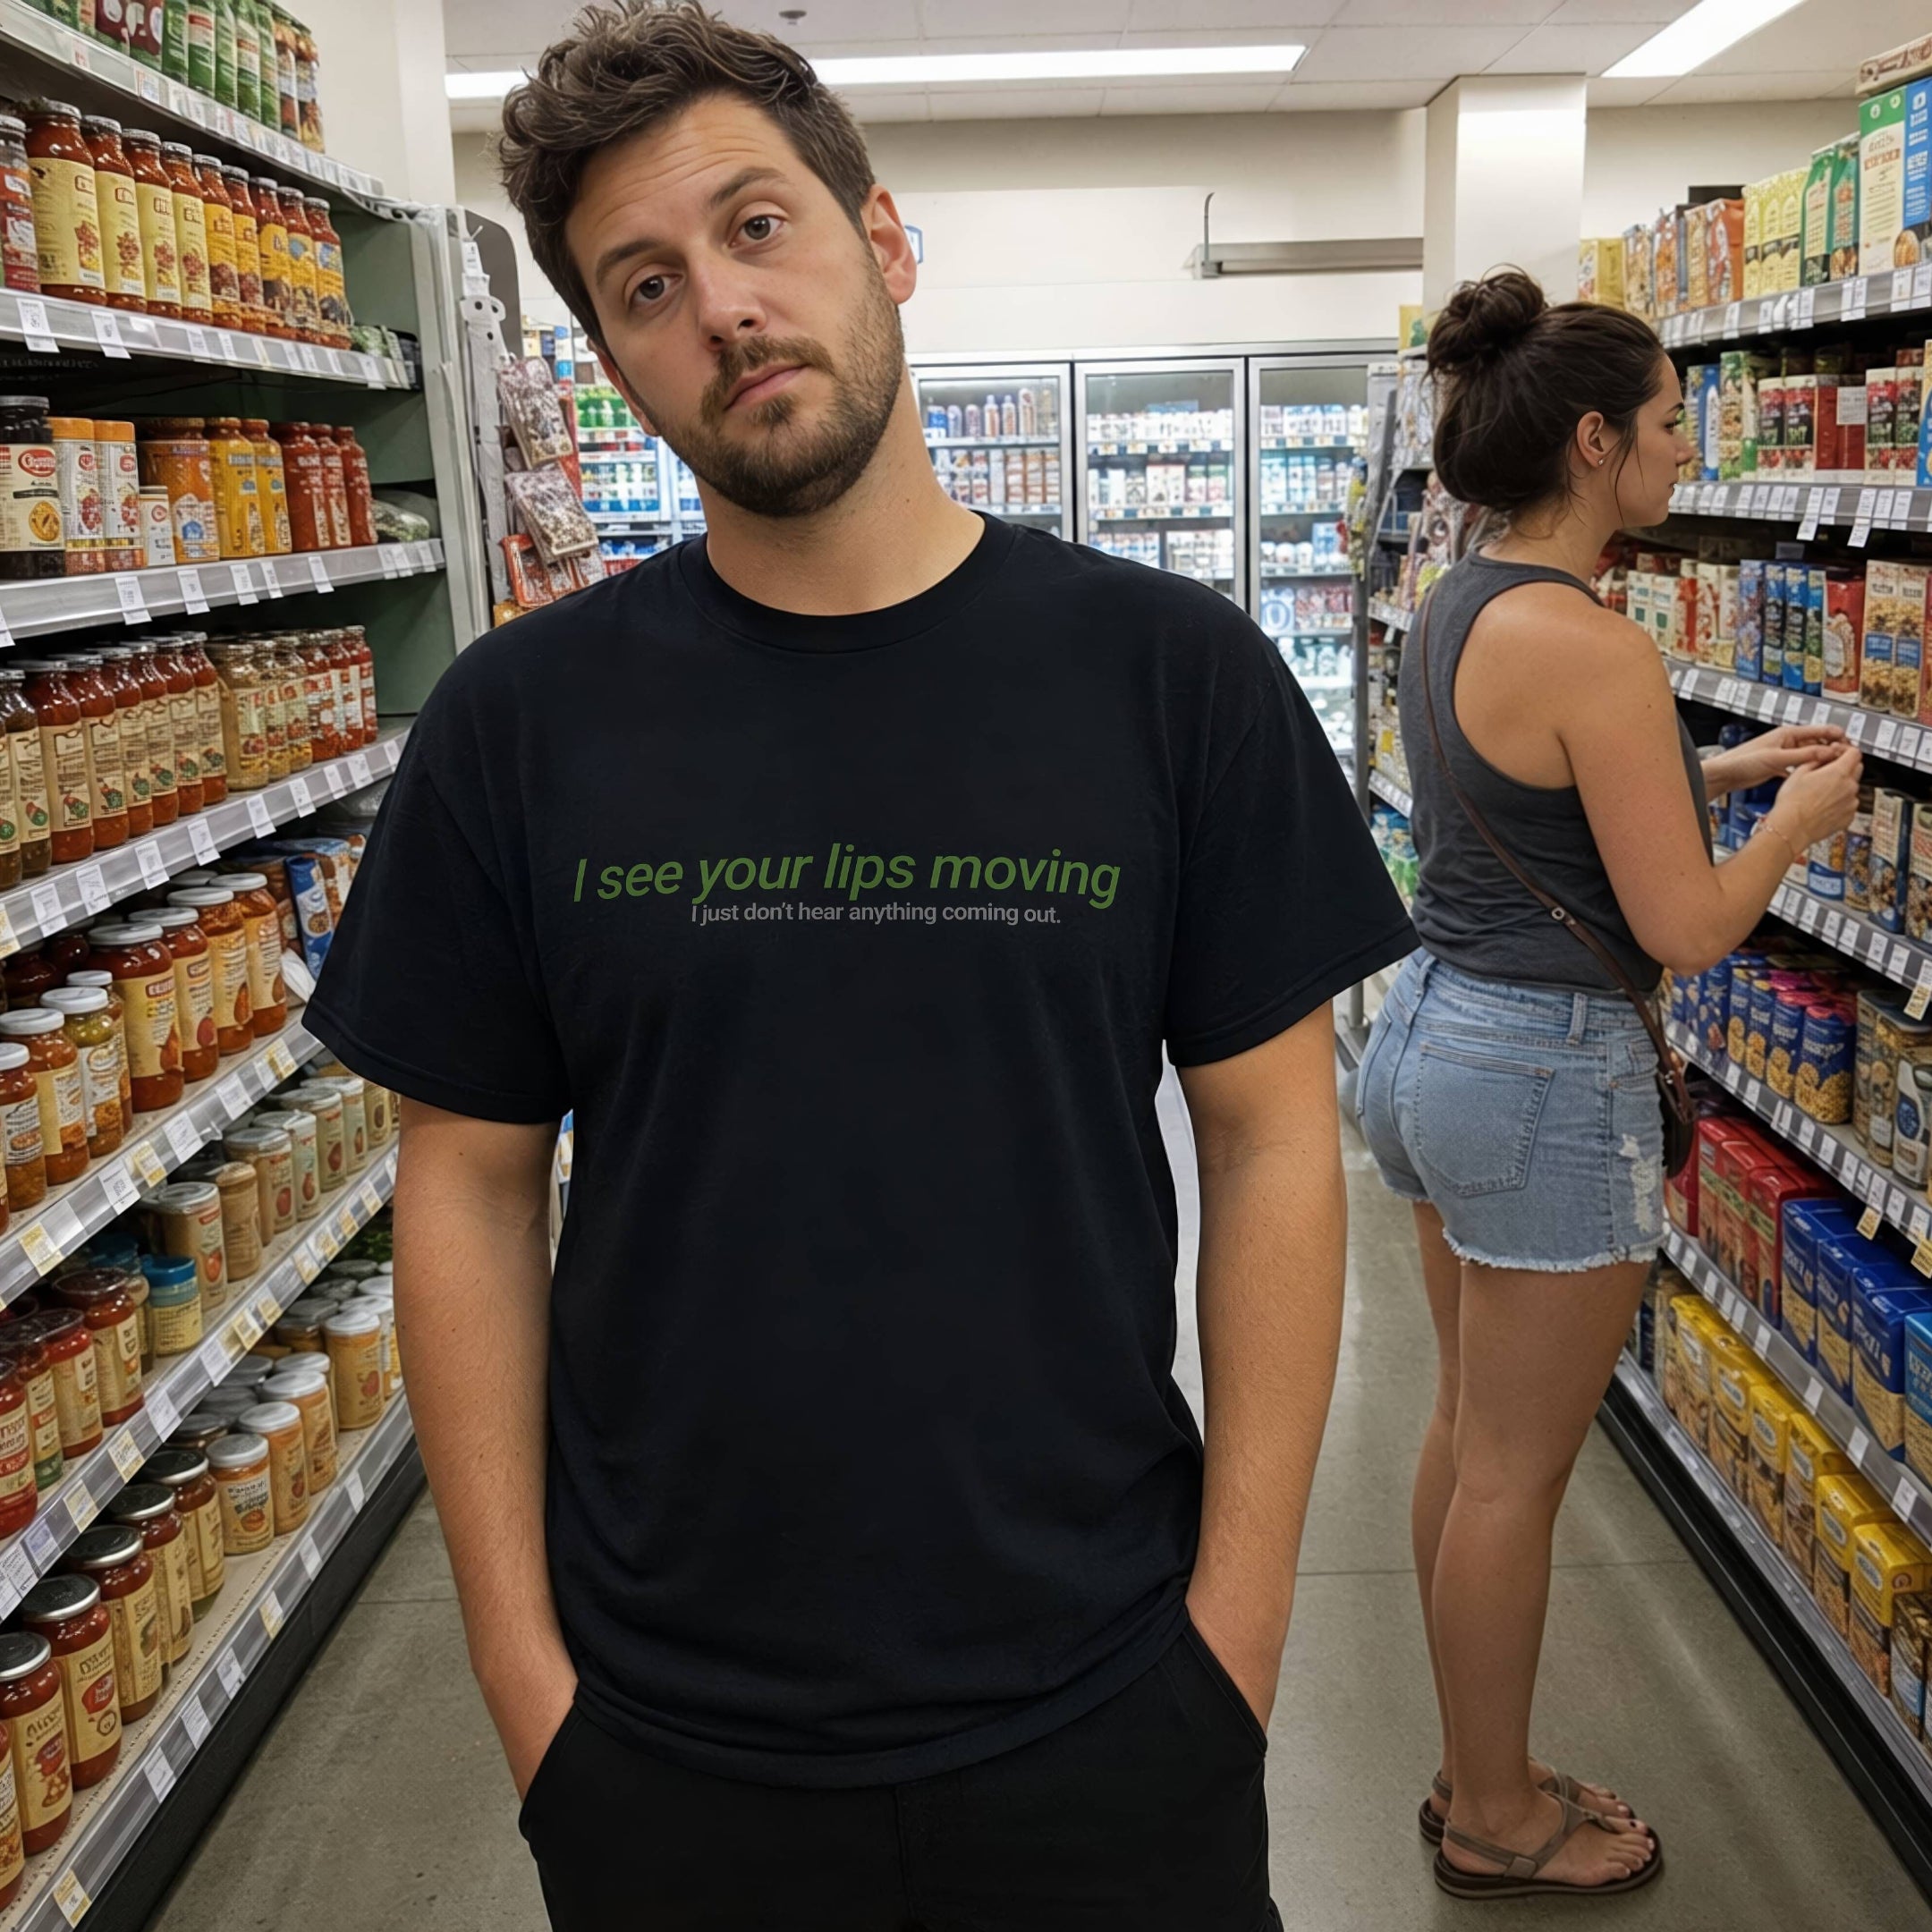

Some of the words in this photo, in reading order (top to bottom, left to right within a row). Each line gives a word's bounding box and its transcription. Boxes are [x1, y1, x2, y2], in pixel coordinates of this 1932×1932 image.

[573, 859, 587, 902] I
[597, 861, 683, 900] see
[691, 855, 814, 905] your
[824, 843, 916, 902] lips
[930, 848, 1121, 910] moving
[691, 905, 698, 922] I
[700, 904, 740, 927] just
[798, 902, 844, 920] hear
[849, 902, 936, 925] anything
[942, 902, 1019, 926] coming
[1023, 907, 1062, 924] out.
